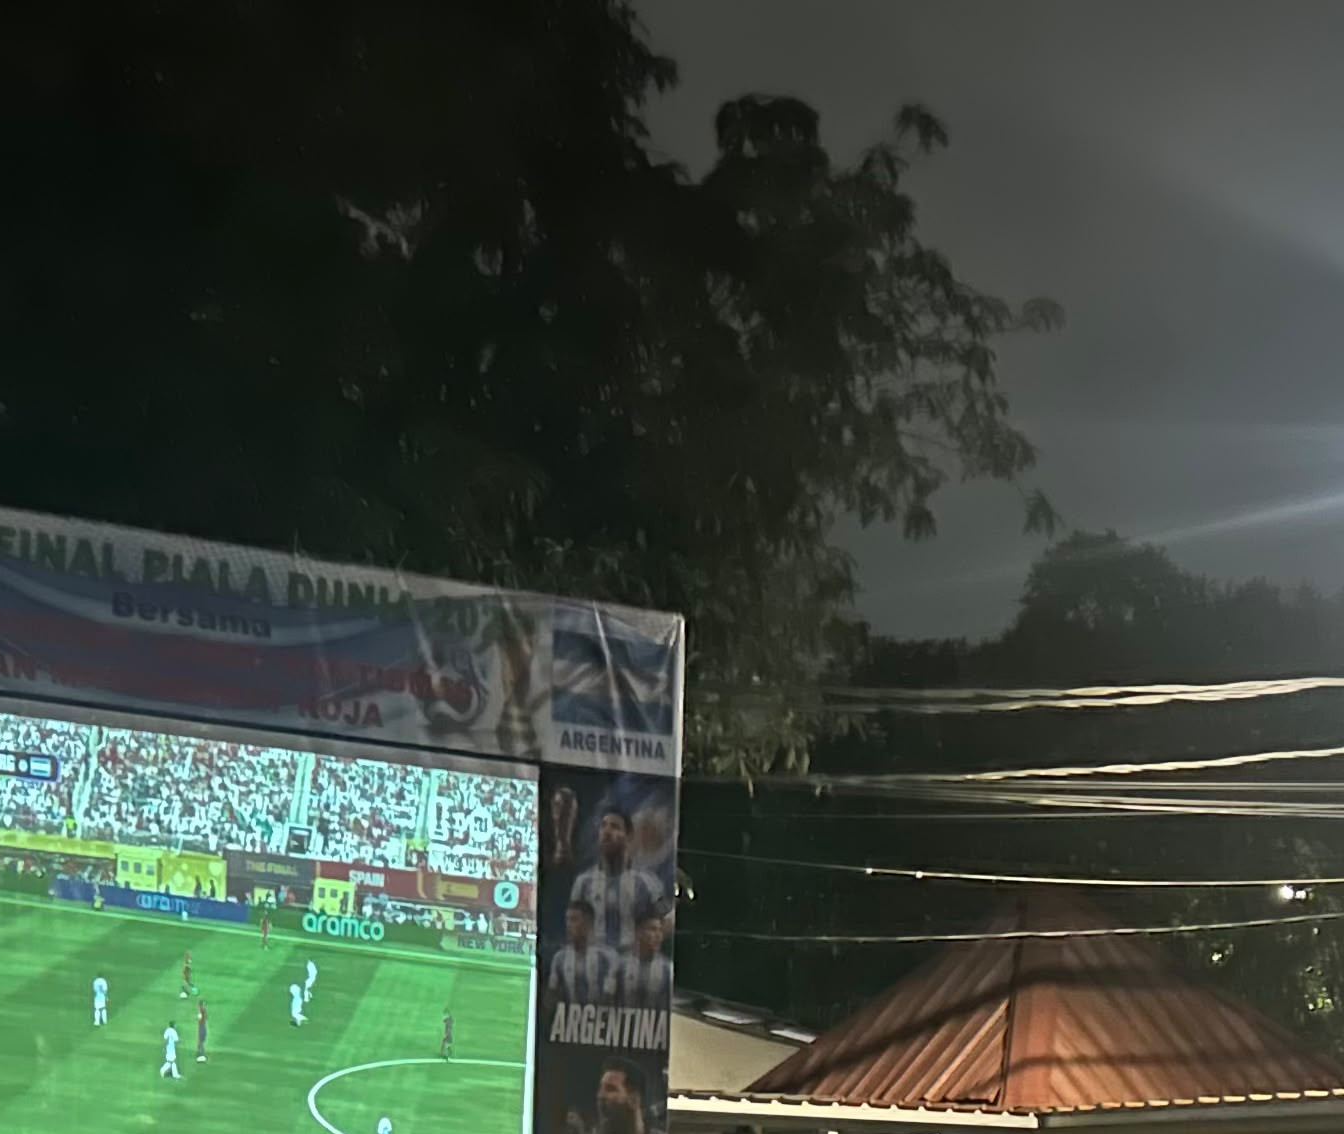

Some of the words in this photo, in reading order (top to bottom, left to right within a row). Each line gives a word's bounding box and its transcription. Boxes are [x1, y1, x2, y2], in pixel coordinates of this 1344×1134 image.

[143, 548, 272, 607] PIALA
[111, 591, 271, 639] Bersama
[559, 729, 666, 760] ARGENTINA
[349, 869, 386, 888] SPAIN
[302, 911, 385, 941] aramco
[550, 1001, 668, 1050] ARGENTINA
